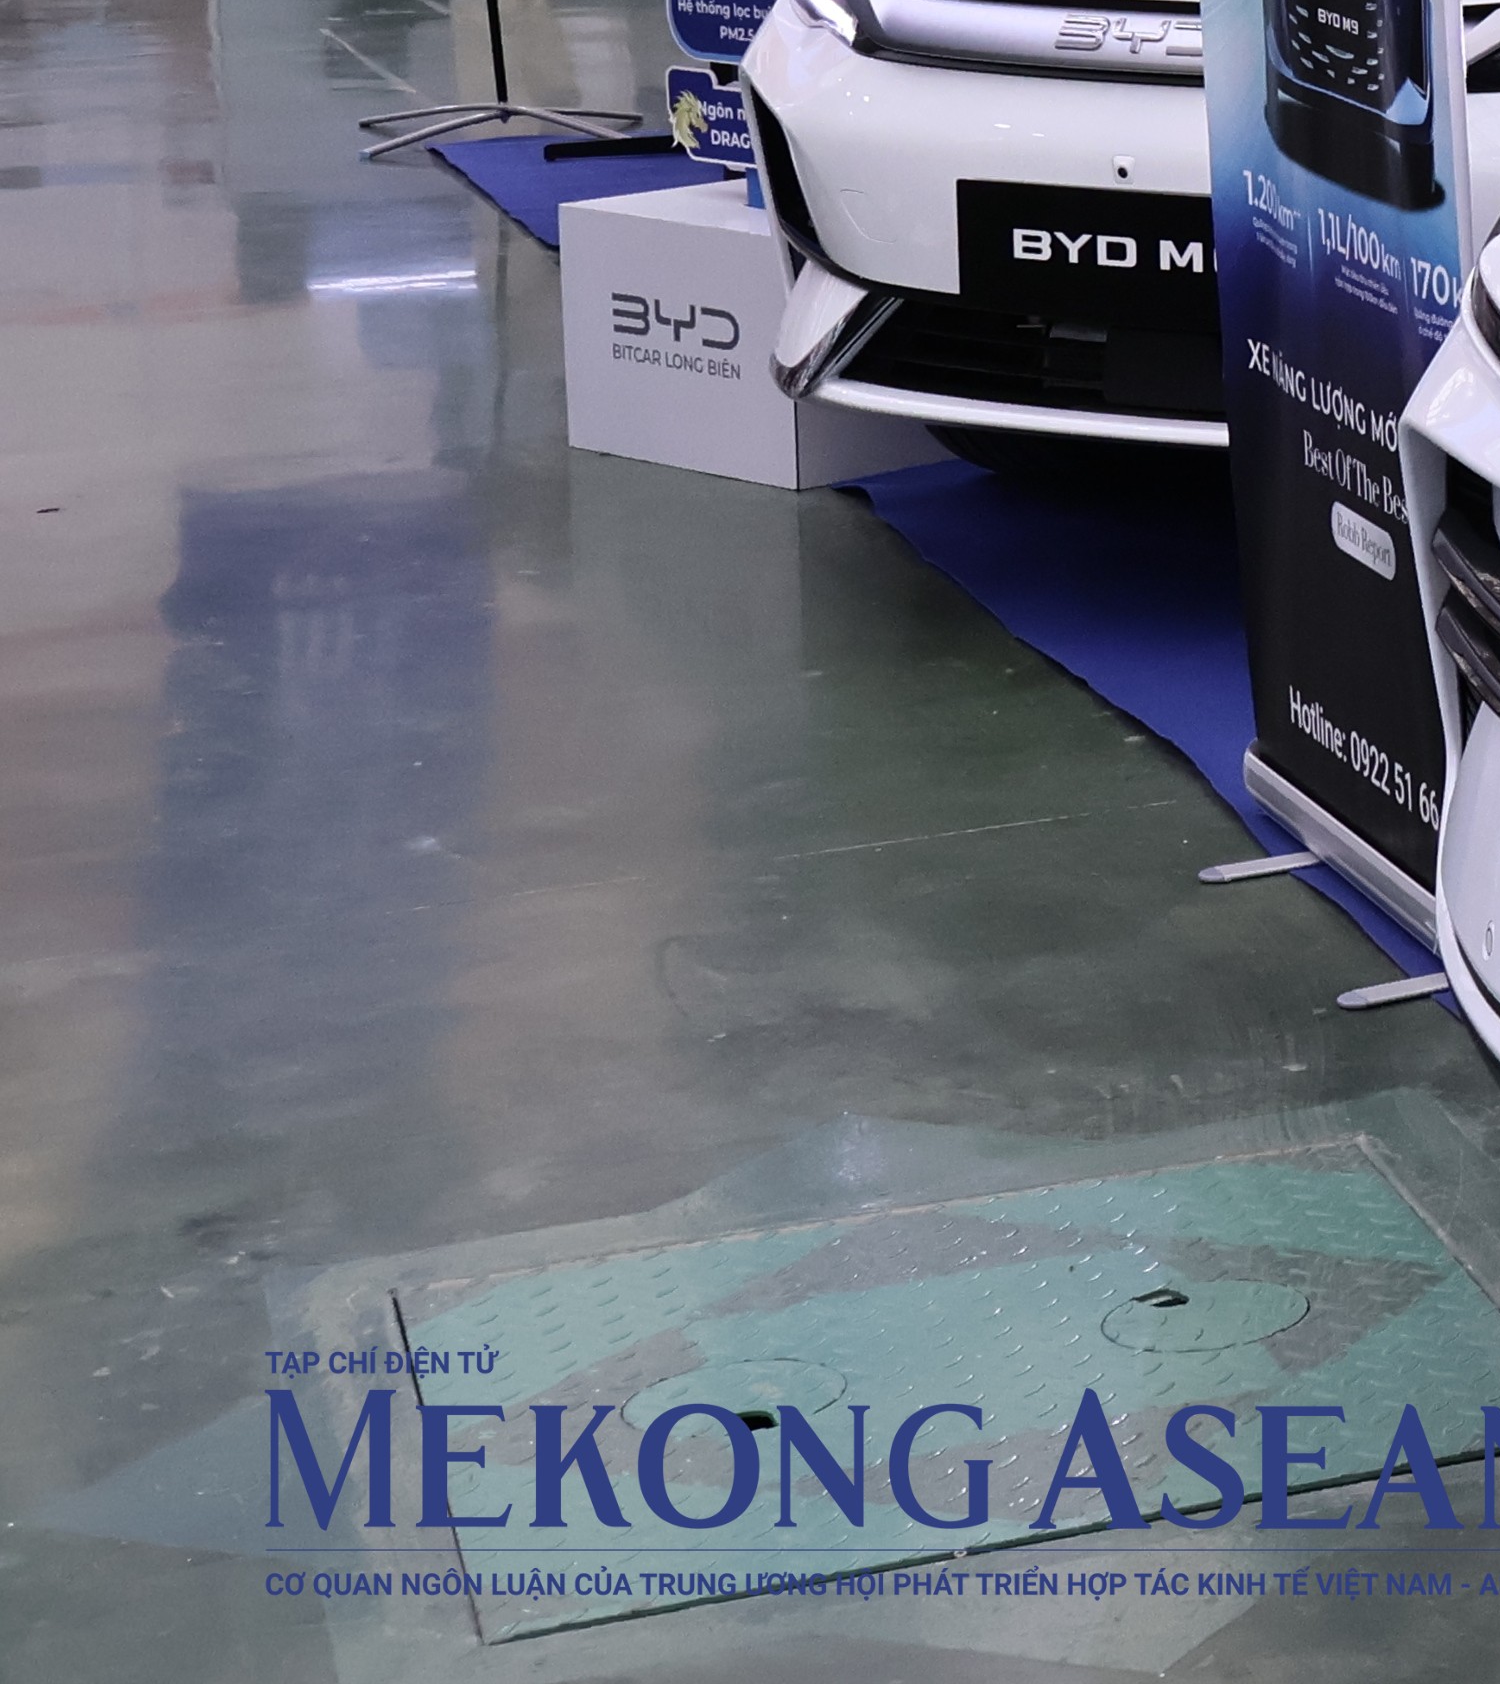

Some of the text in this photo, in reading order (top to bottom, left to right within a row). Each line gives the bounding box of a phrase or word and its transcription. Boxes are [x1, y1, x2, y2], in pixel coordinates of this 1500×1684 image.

[1318, 8, 1341, 29] BYD
[1012, 230, 1137, 267] BYD
[611, 292, 740, 350] BYD
[612, 344, 741, 380] BITCAR LONG BIÊN
[1303, 429, 1409, 523] Best Of The Bes
[1289, 685, 1347, 762] Hotline:
[1350, 729, 1390, 796] 0922
[1394, 764, 1413, 812] 51
